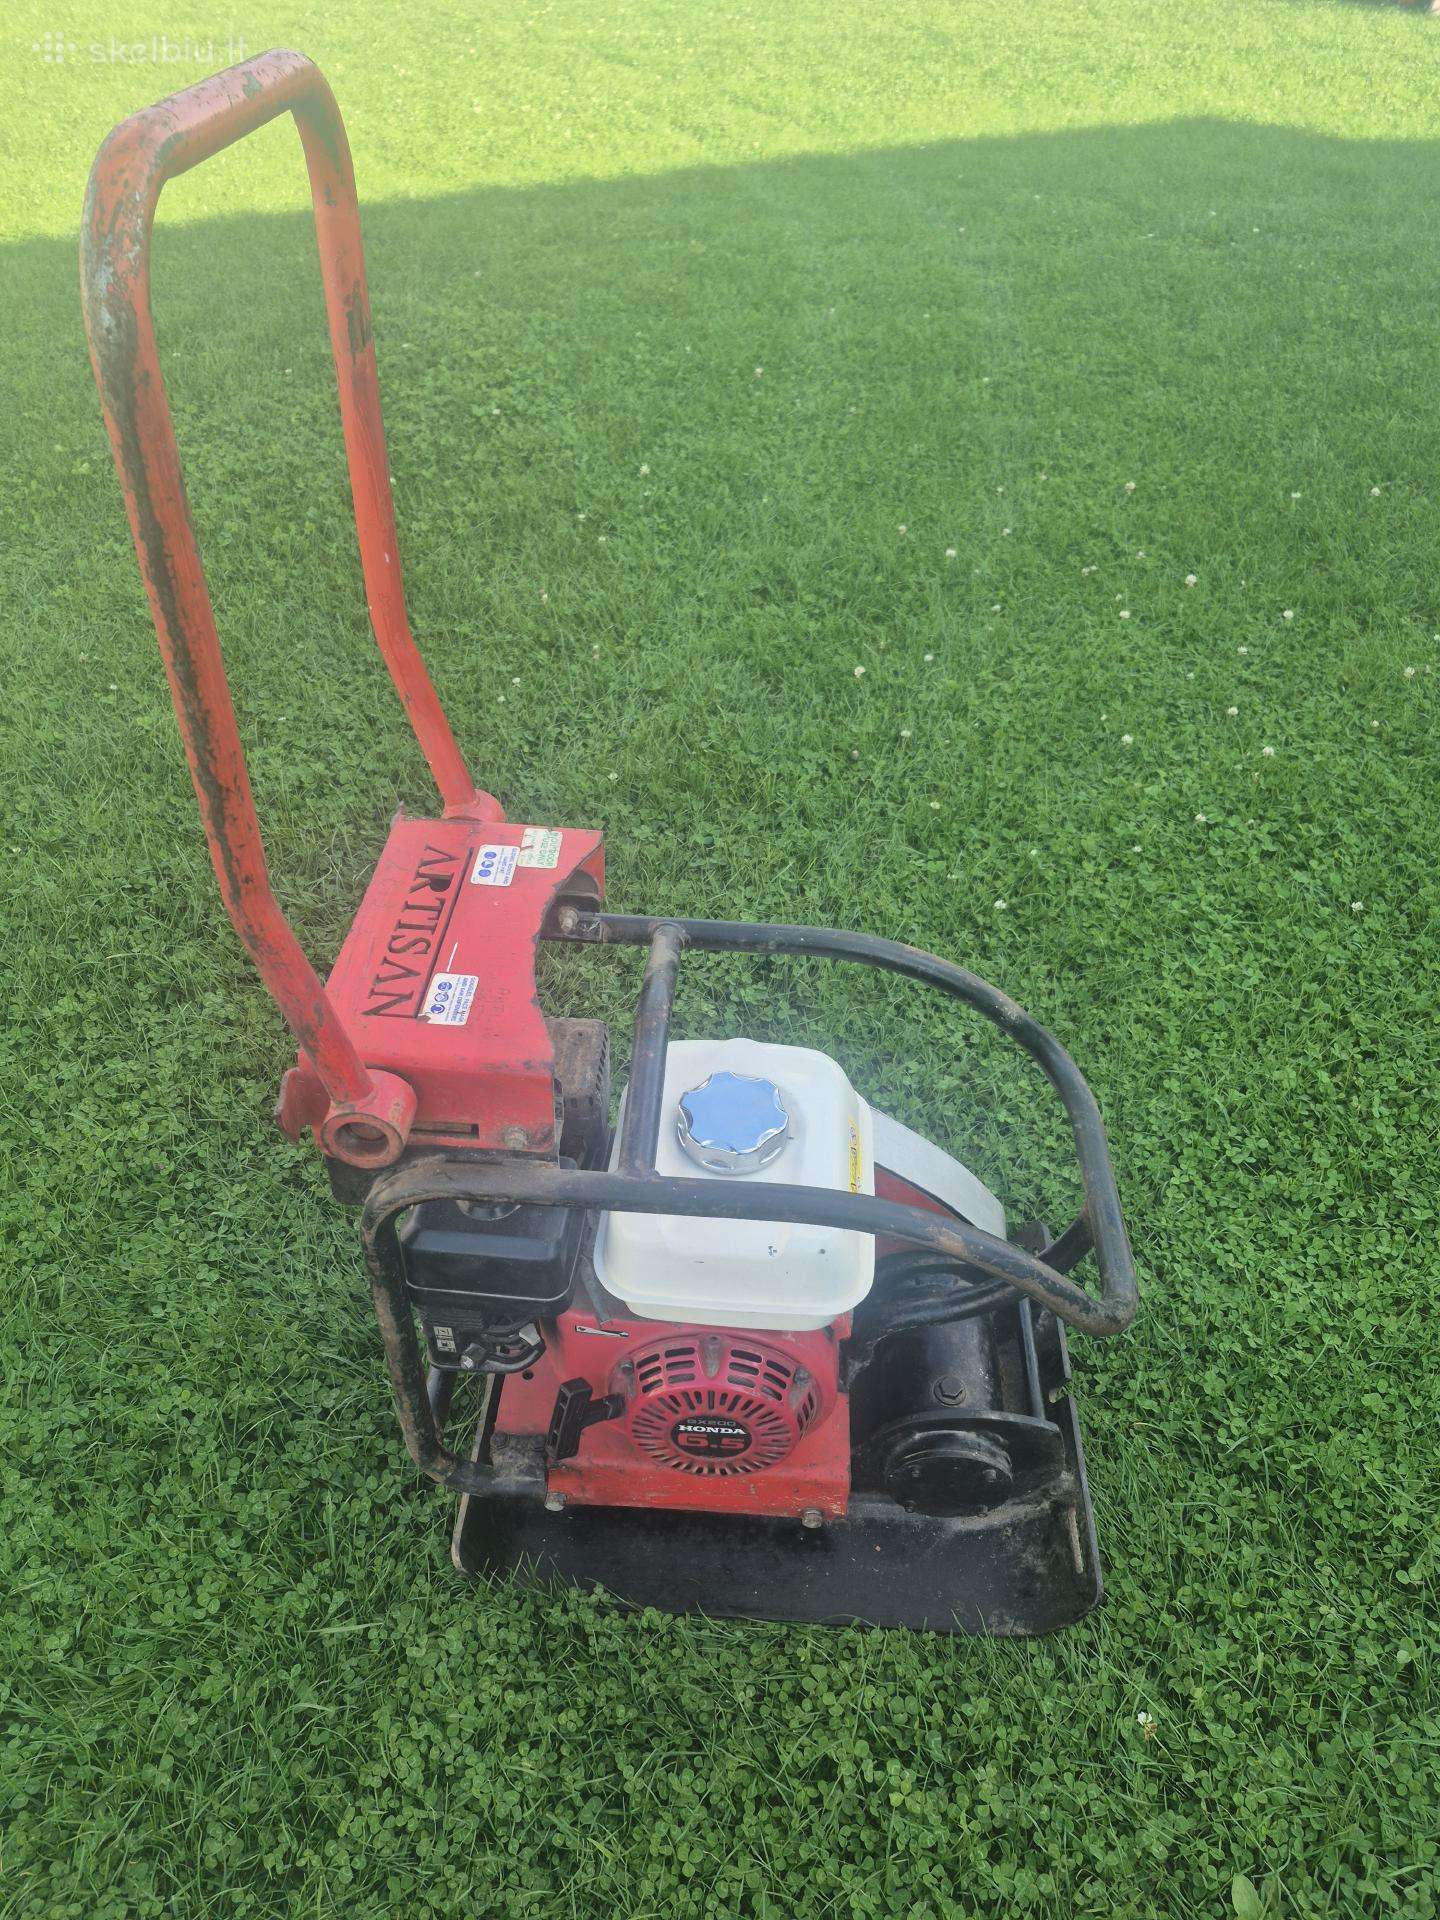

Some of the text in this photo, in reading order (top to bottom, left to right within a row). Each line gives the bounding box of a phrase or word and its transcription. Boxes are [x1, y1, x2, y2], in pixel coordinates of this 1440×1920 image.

[362, 843, 461, 1019] ARTISAN
[679, 1424, 747, 1434] HONDA
[678, 1433, 745, 1449] 6.5
